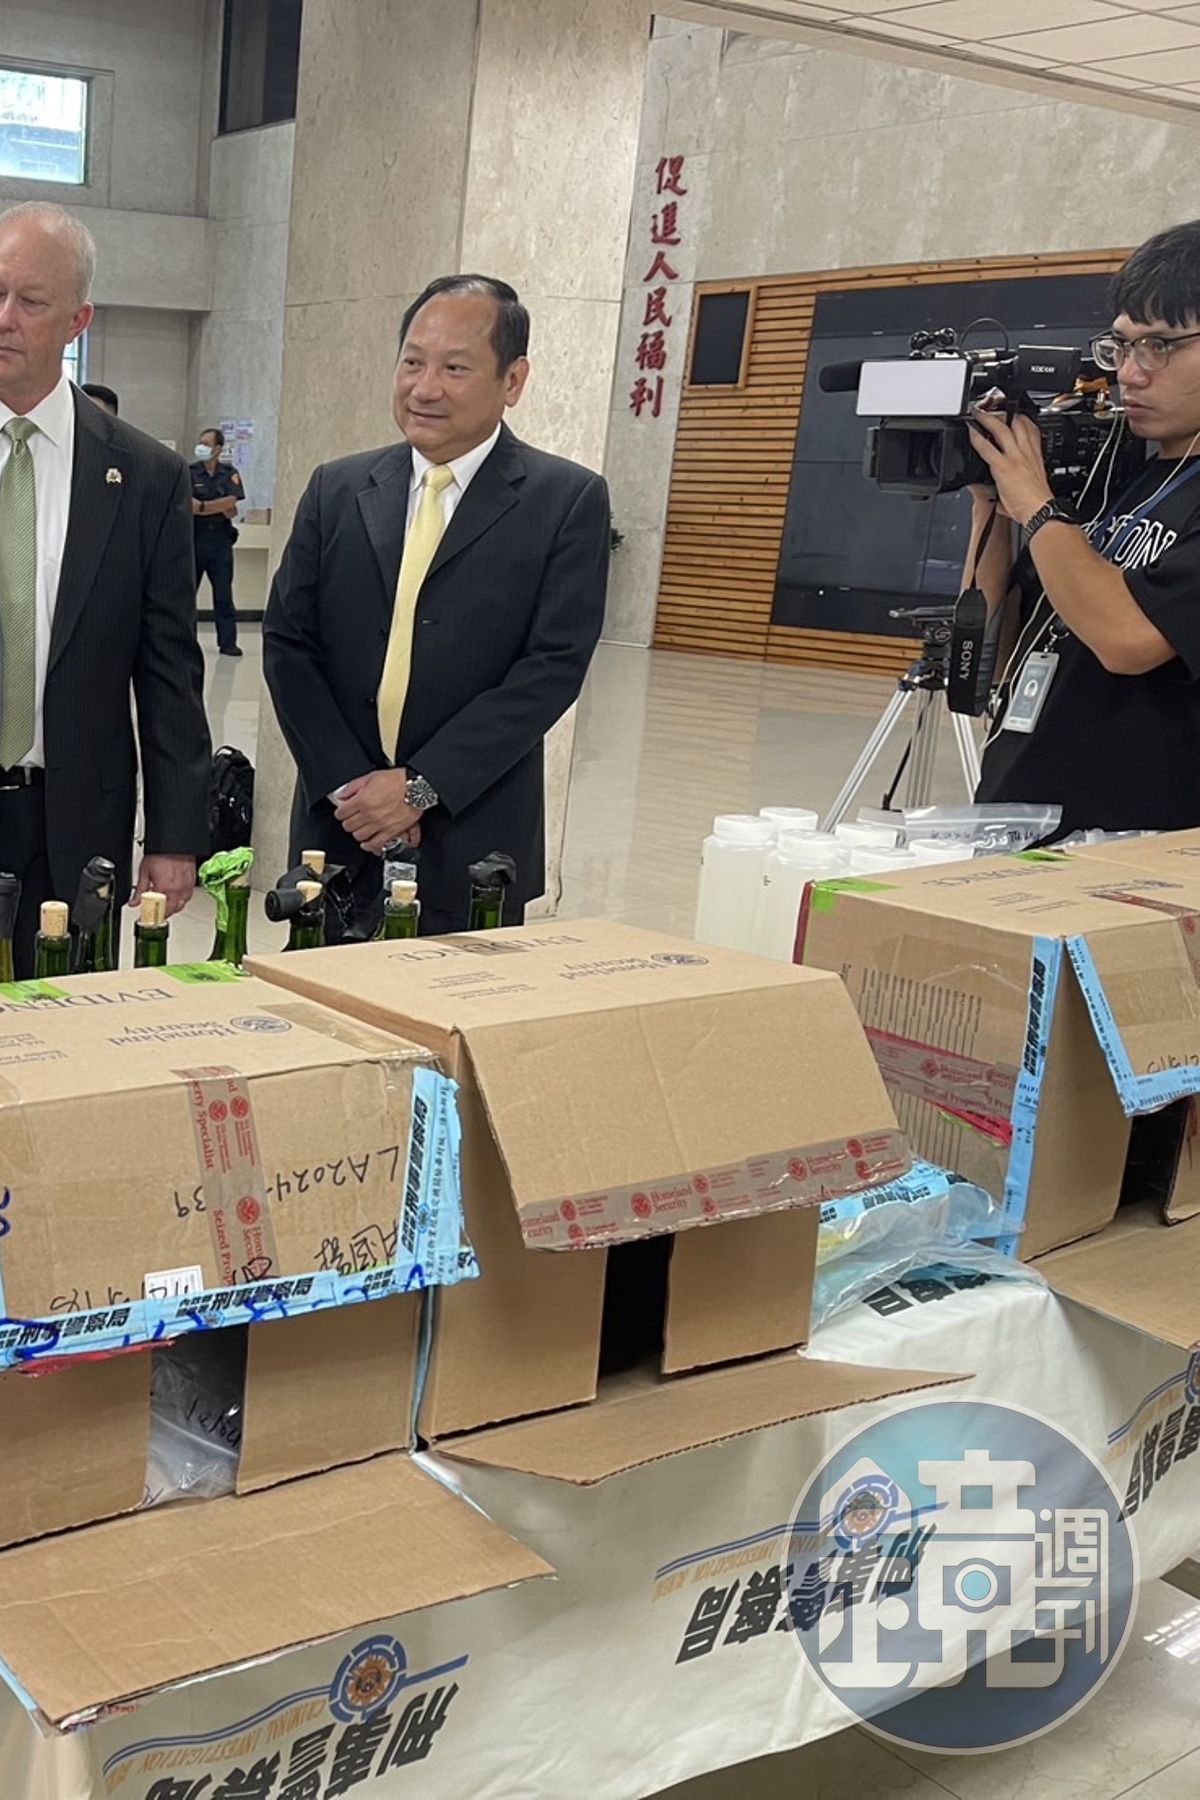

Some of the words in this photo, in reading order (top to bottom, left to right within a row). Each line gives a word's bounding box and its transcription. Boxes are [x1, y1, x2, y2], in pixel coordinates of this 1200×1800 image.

[629, 155, 688, 418] 促進人民福利
[958, 640, 974, 682] SONY
[108, 1024, 240, 1048] Homeland
[123, 1019, 225, 1037] Security
[198, 1109, 215, 1169] Specialist
[650, 1186, 693, 1202] Homeland
[653, 1199, 688, 1214] Security
[213, 1209, 230, 1251] Seized
[521, 1211, 561, 1229] omeland
[220, 1251, 234, 1287] Prop
[209, 1276, 316, 1312] 刑事警察局
[18, 1307, 132, 1347] 刑事警察局
[674, 1522, 938, 1665] 刑事警察局
[265, 1699, 329, 1749] CRIMINAL
[137, 1727, 261, 1775] INVESTIGATION
